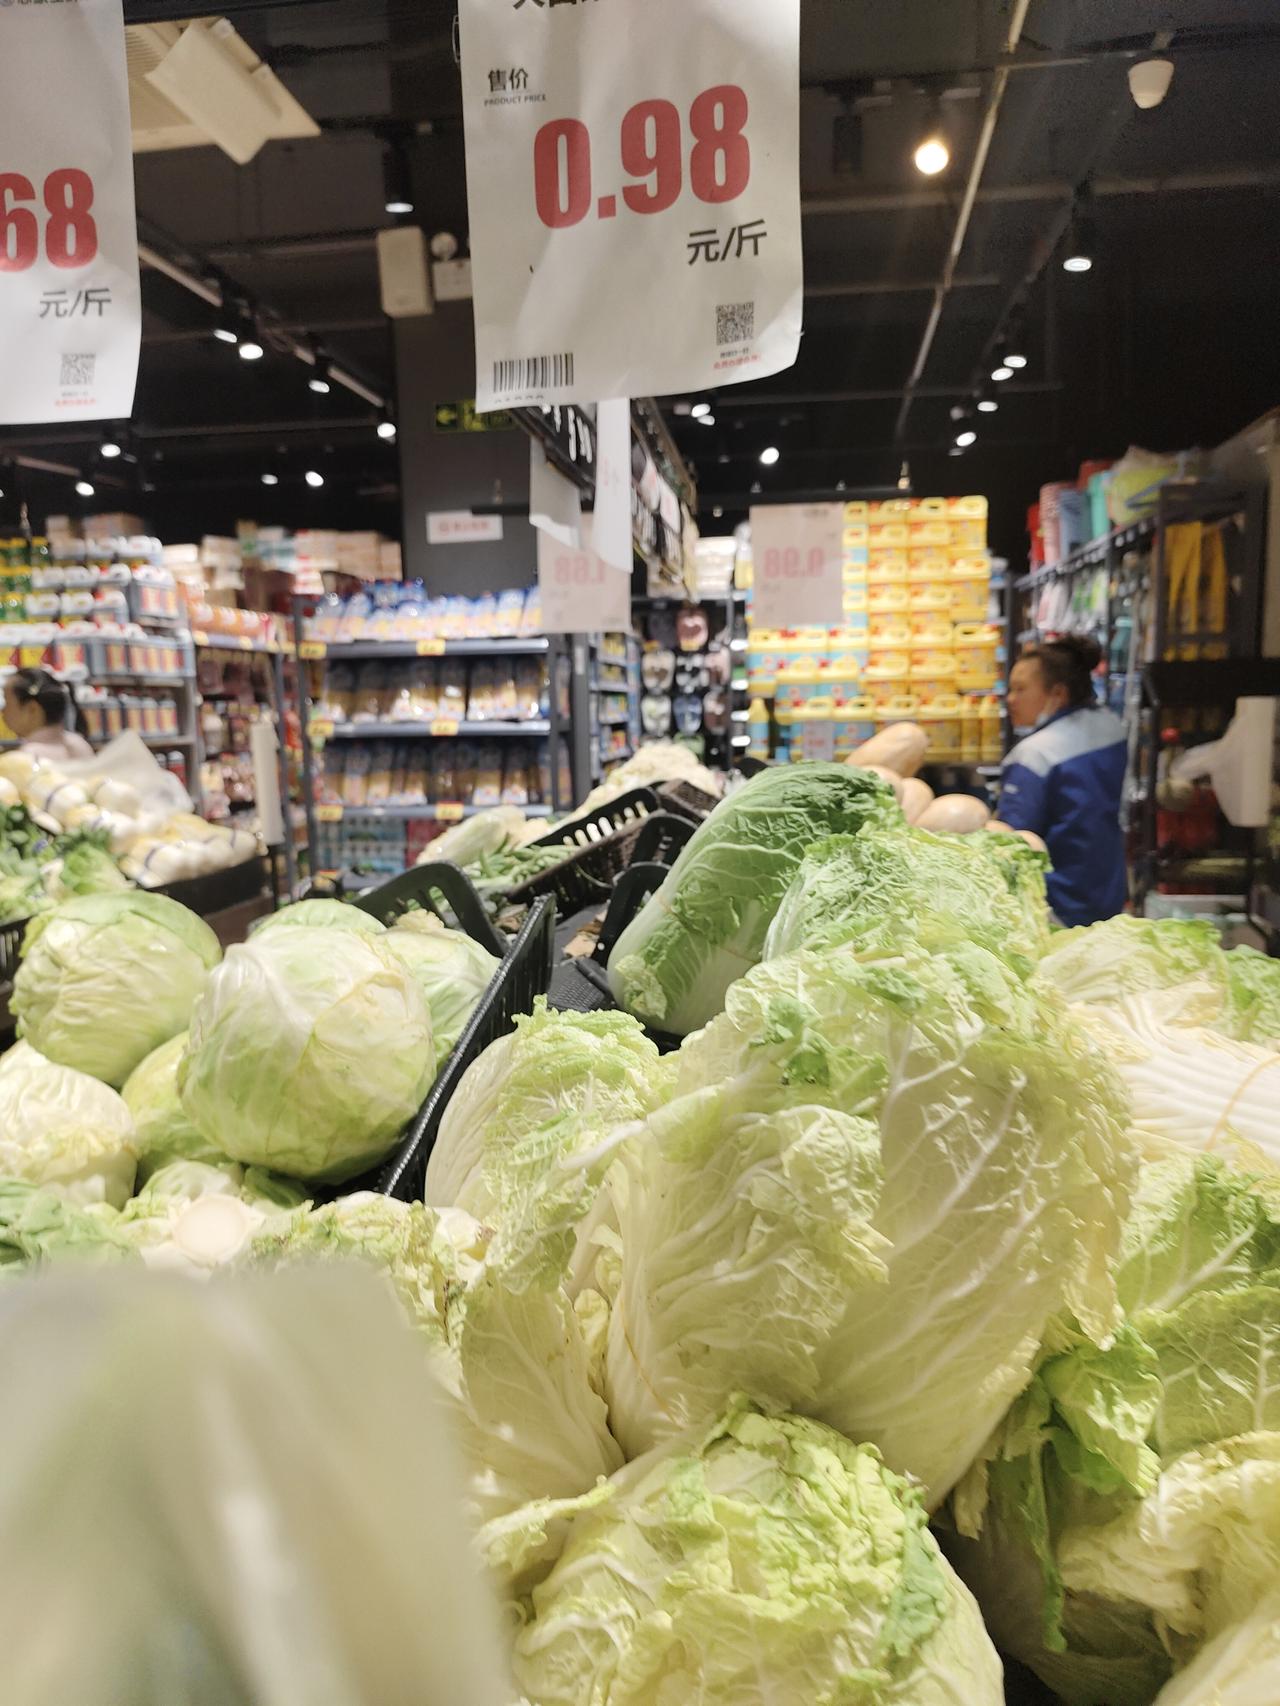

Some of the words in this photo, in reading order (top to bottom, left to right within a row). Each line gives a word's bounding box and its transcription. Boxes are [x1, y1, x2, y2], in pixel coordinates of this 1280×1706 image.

[487, 67, 530, 92] 售价
[484, 95, 522, 107] PRODUCT
[524, 93, 547, 102] PRICE
[533, 85, 750, 229] 0.98
[687, 219, 768, 266] 元/斤
[39, 288, 112, 319] 元/斤
